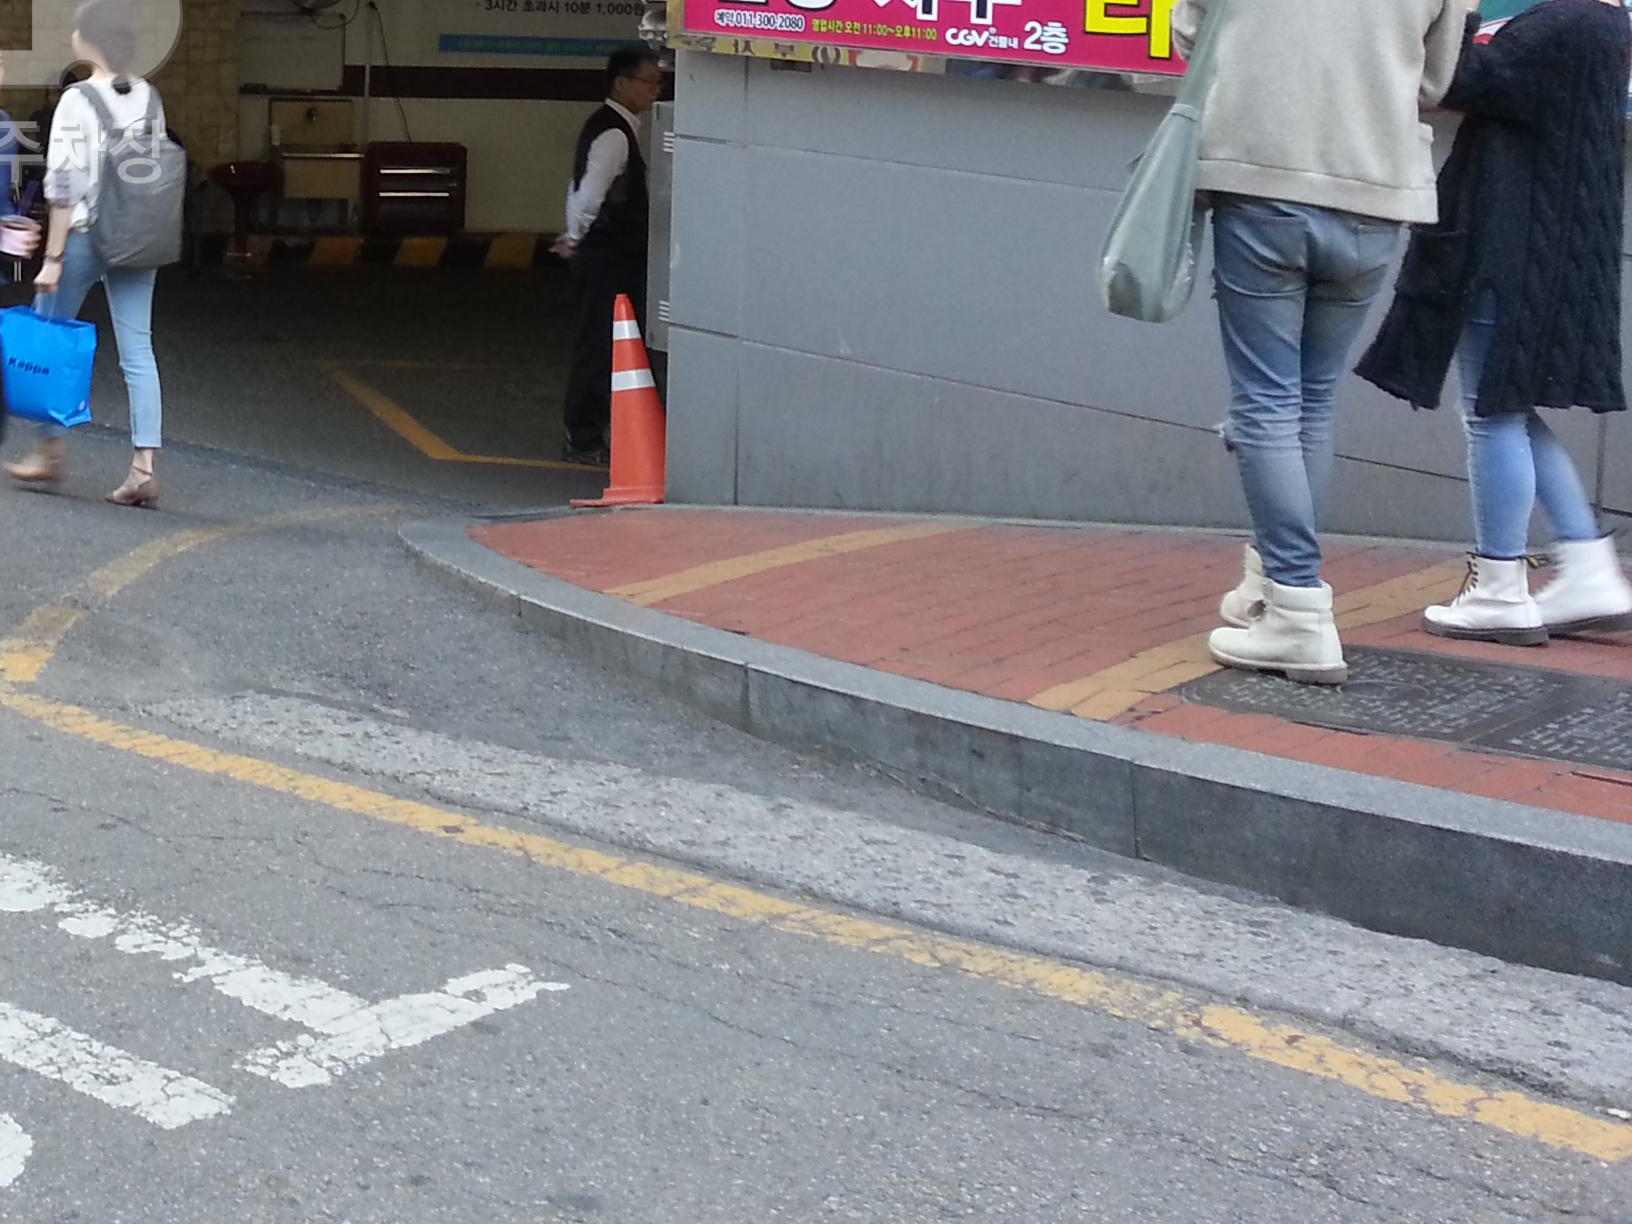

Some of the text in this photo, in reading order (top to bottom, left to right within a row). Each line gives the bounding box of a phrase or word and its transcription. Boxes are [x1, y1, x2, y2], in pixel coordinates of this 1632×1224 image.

[483, 0, 519, 13] 3시간
[945, 26, 989, 48] CGV
[1023, 20, 1070, 54] 2층
